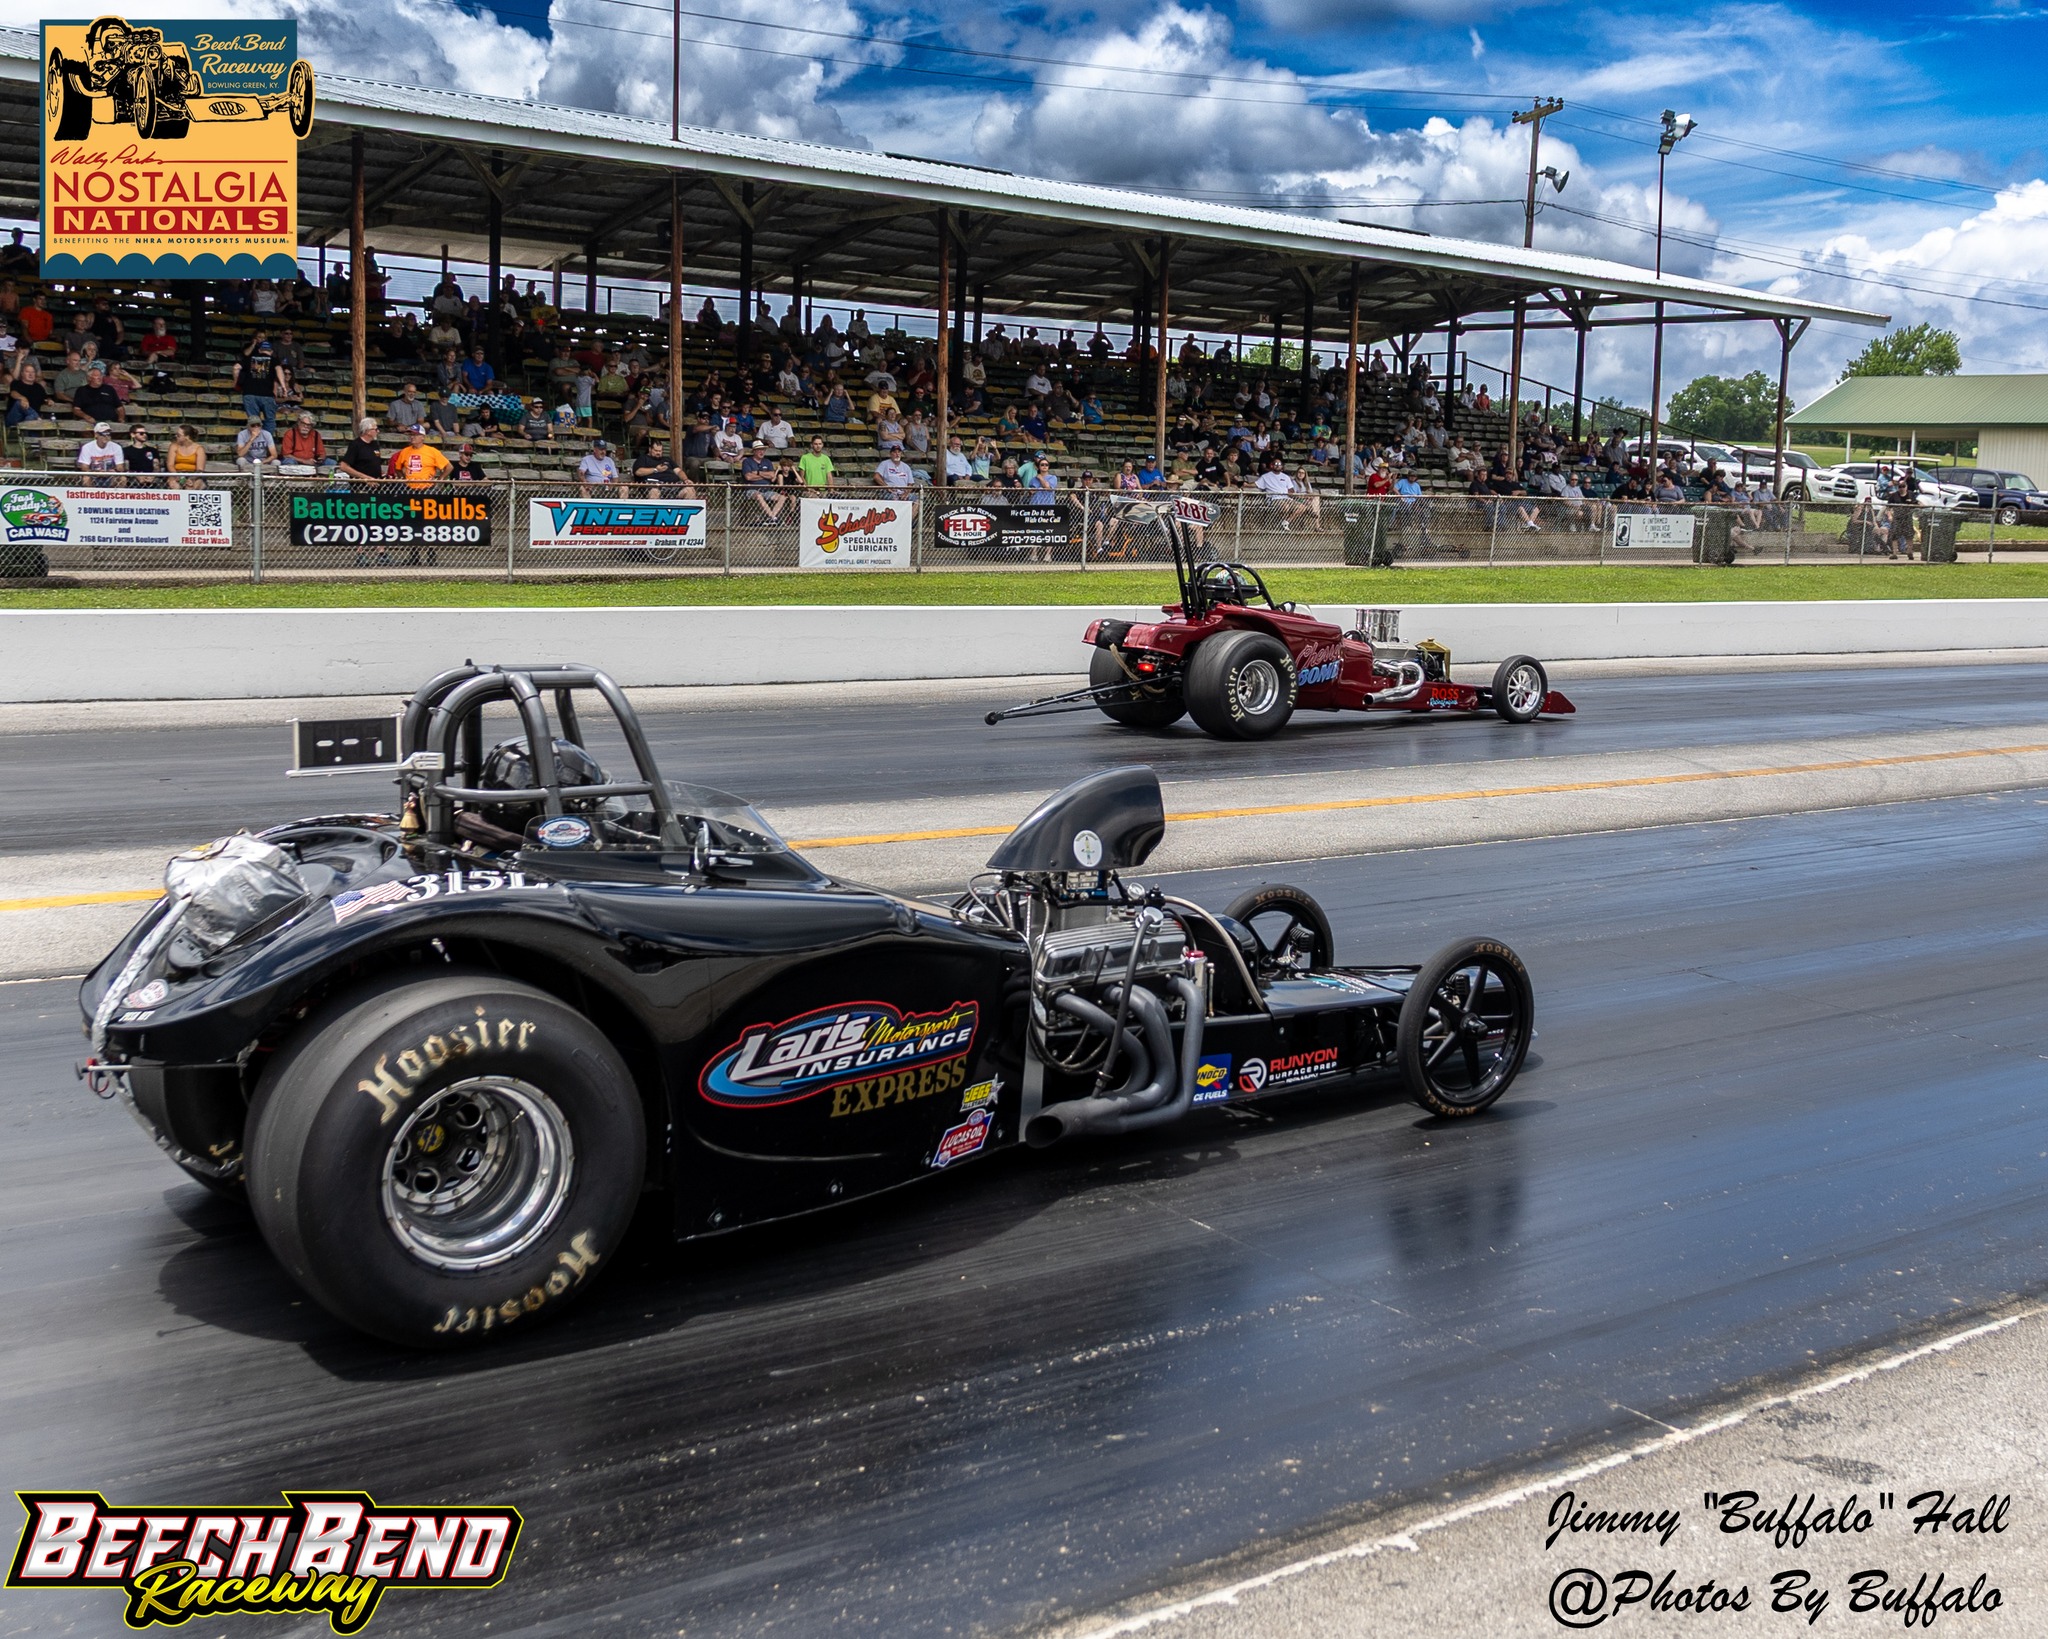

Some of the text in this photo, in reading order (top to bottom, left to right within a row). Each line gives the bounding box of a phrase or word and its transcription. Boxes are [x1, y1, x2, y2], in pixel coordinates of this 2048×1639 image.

[10, 492, 34, 503] Fast
[3, 499, 48, 512] Freddy's
[83, 507, 113, 515] BOWLING
[114, 507, 135, 515] GREEN
[135, 508, 170, 516] LOCATIONS
[105, 517, 133, 525] Fairview
[546, 501, 704, 536] VINCENT
[938, 509, 959, 521] TRUCK
[976, 507, 998, 521] REPAIR
[569, 525, 690, 536] PERFORMANCE
[816, 507, 897, 546] Schaeffer's
[943, 518, 991, 532] FELTS
[8, 527, 66, 539] CAR WASH
[135, 536, 169, 544] Boulevard
[303, 523, 481, 545] (270)393-8880
[1001, 535, 1067, 544] 270-796-9100
[210, 537, 230, 545] Wash
[654, 538, 677, 546] Graham,
[686, 538, 704, 546] 42344
[1431, 688, 1459, 700] ROSS
[730, 1010, 973, 1082] Laris Motorsports
[795, 1027, 972, 1078] INSURANCE
[357, 1005, 536, 1126] Hoosier
[1270, 1047, 1338, 1073] RUNYON
[1197, 1067, 1227, 1080] NOCO
[1269, 1061, 1337, 1081] SURFACE PREP
[830, 1055, 968, 1118] EXPRESS
[963, 1083, 993, 1103] JEGS
[1193, 1089, 1228, 1101] CE FUELS
[942, 1127, 972, 1150] LUCAS
[970, 1124, 984, 1139] OIL
[433, 1229, 600, 1335] Hoosier
